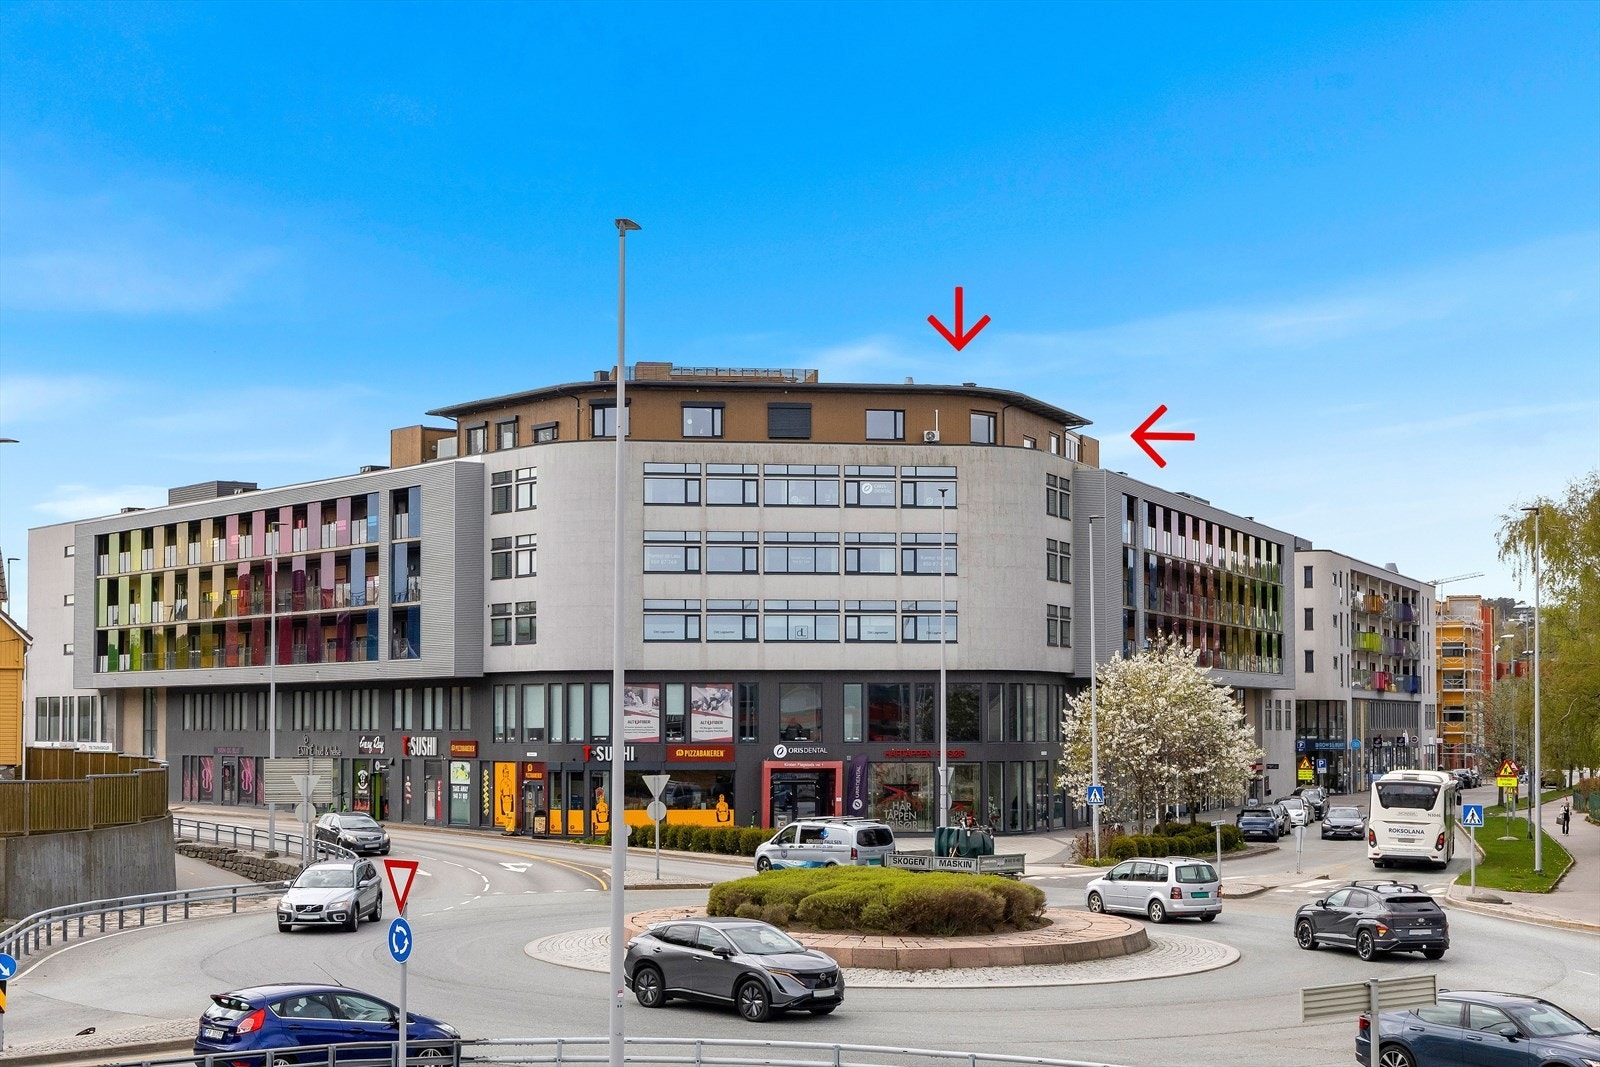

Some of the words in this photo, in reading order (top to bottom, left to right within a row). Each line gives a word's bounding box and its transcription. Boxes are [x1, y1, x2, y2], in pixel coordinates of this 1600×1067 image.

[373, 736, 385, 754] Day
[410, 736, 438, 756] SUSHI
[596, 746, 634, 762] SUHI
[936, 750, 967, 758] FSØR
[892, 800, 912, 811] HÅR
[884, 809, 917, 820] TÅPPEN
[892, 857, 926, 866] SKOGEN
[938, 859, 972, 868] MASKIN
